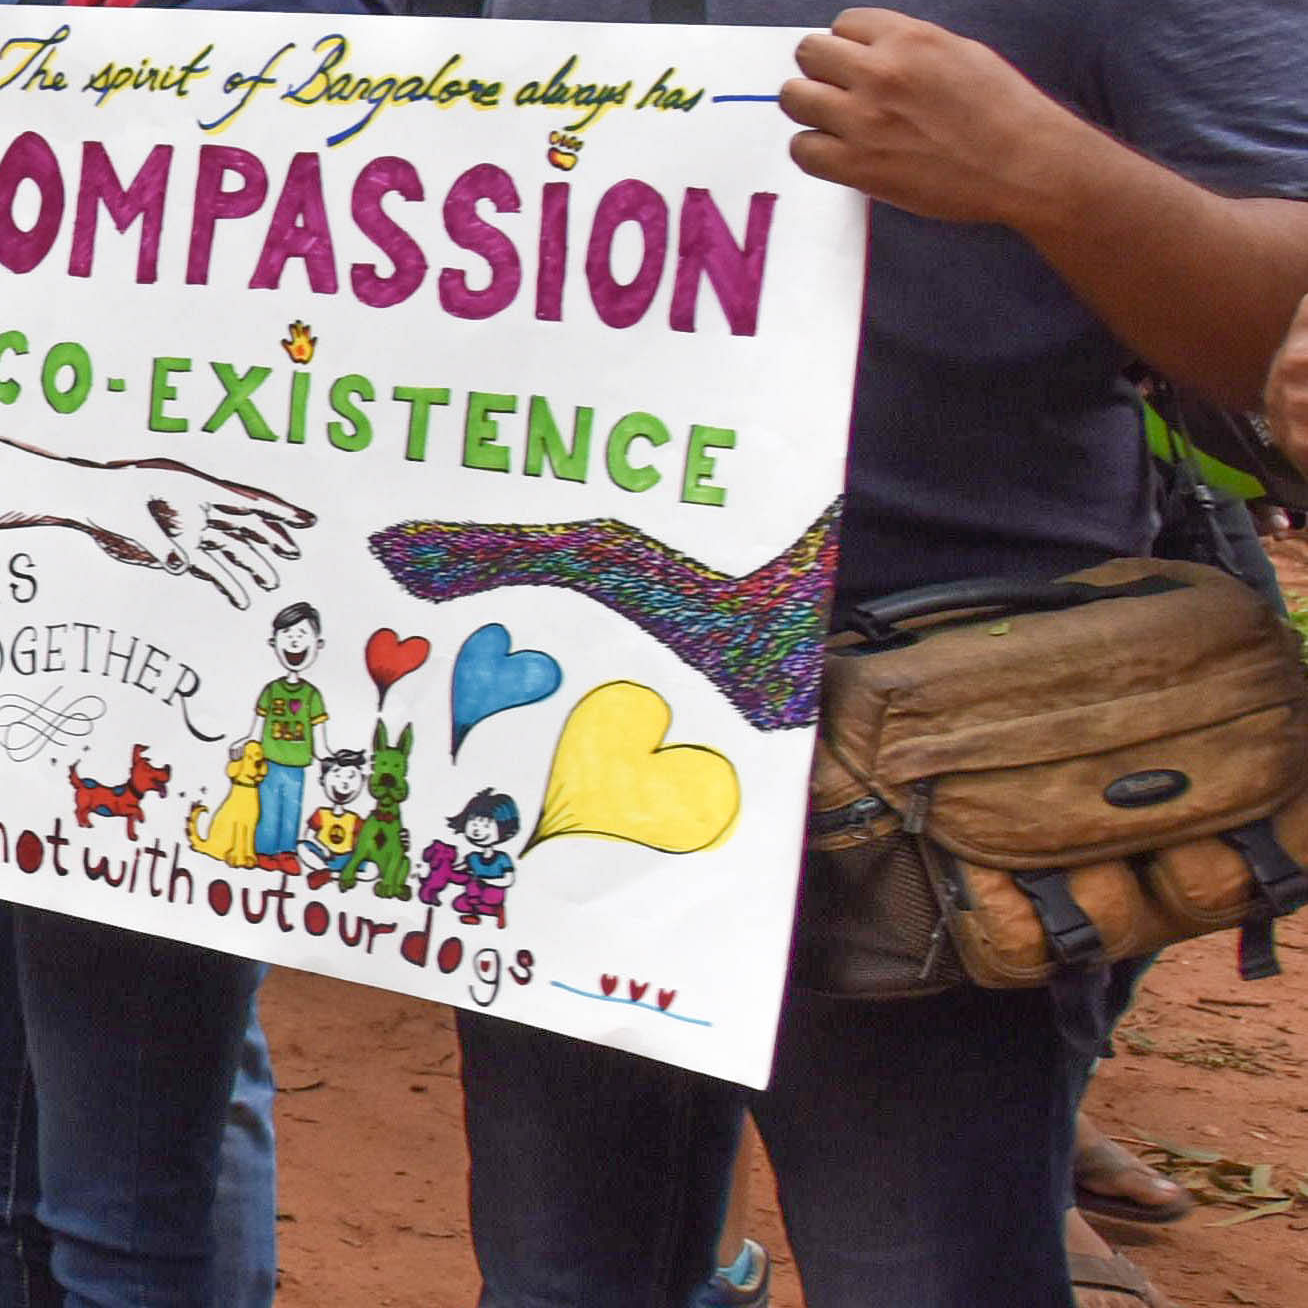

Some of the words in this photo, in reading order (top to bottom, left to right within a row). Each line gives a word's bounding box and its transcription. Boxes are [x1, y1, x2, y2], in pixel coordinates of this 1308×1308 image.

[84, 44, 216, 108] spirit
[197, 42, 298, 133] of
[280, 33, 504, 148] Bangalore
[514, 54, 638, 133] always
[634, 66, 708, 113] has
